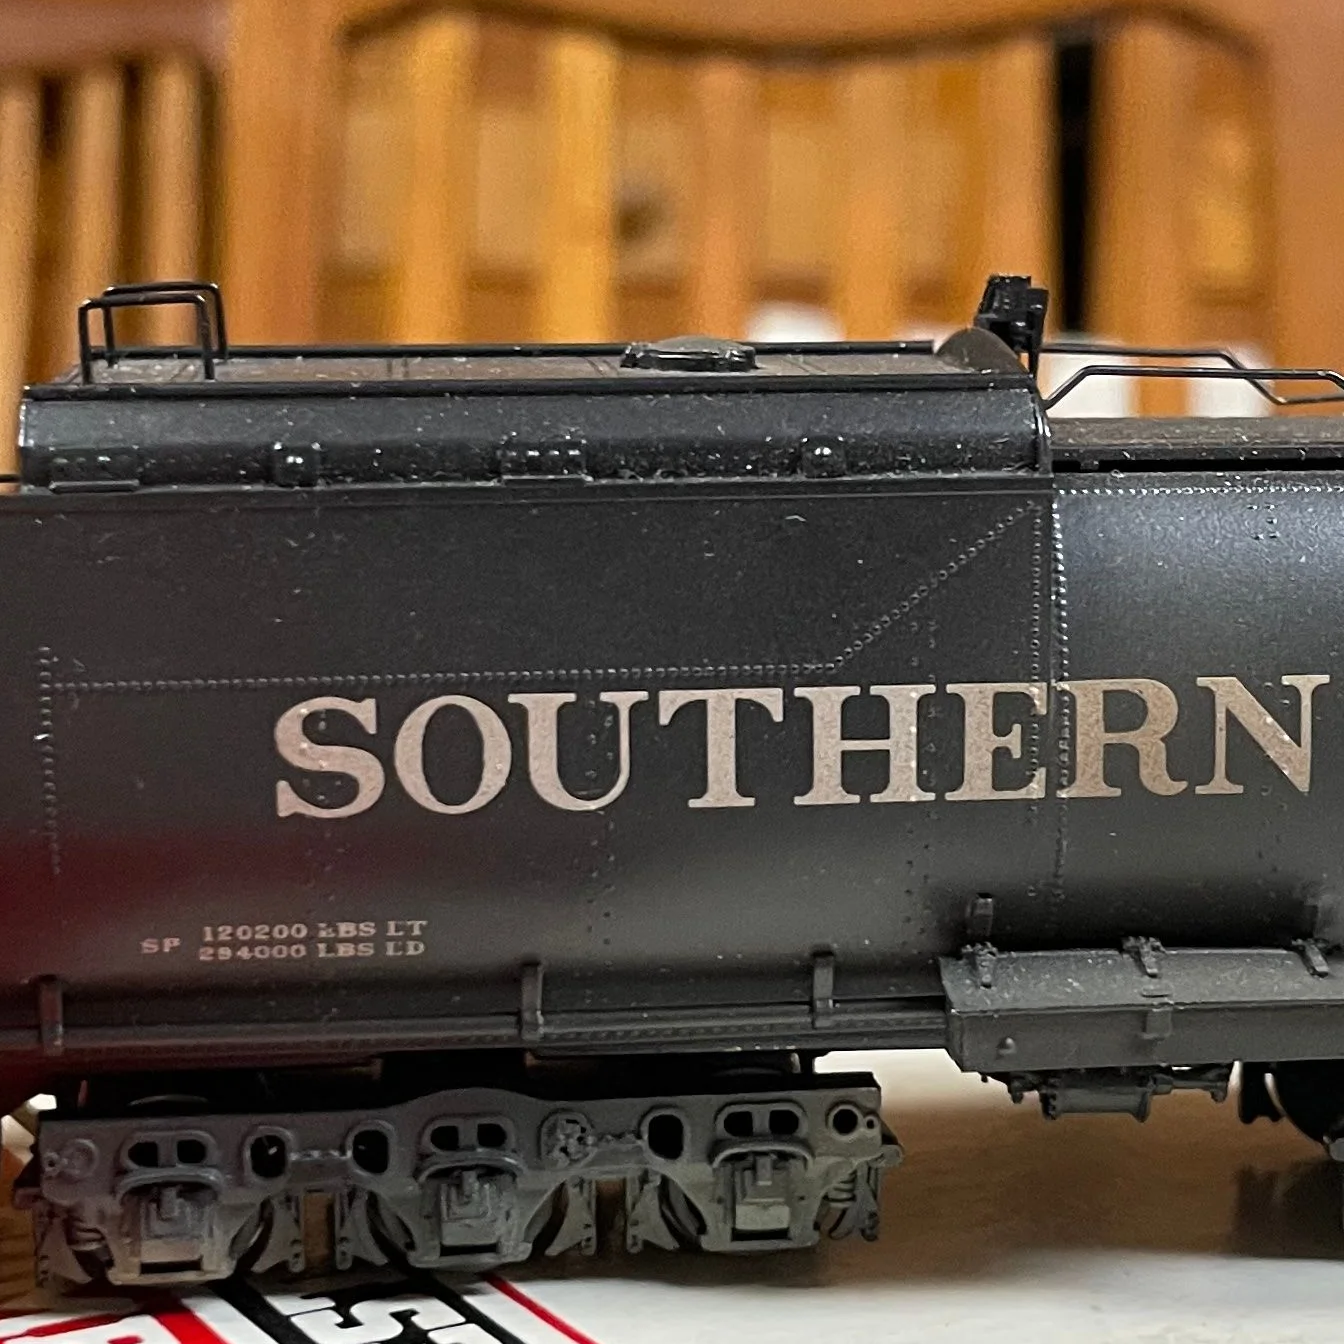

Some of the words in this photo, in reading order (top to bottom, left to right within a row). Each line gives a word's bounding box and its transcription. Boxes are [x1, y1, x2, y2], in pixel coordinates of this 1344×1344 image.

[273, 674, 1331, 818] SOUTHERN
[203, 923, 307, 942] 120200
[386, 920, 428, 937] LT
[141, 938, 181, 954] SP
[316, 940, 375, 957] LBS
[386, 940, 426, 956] LD
